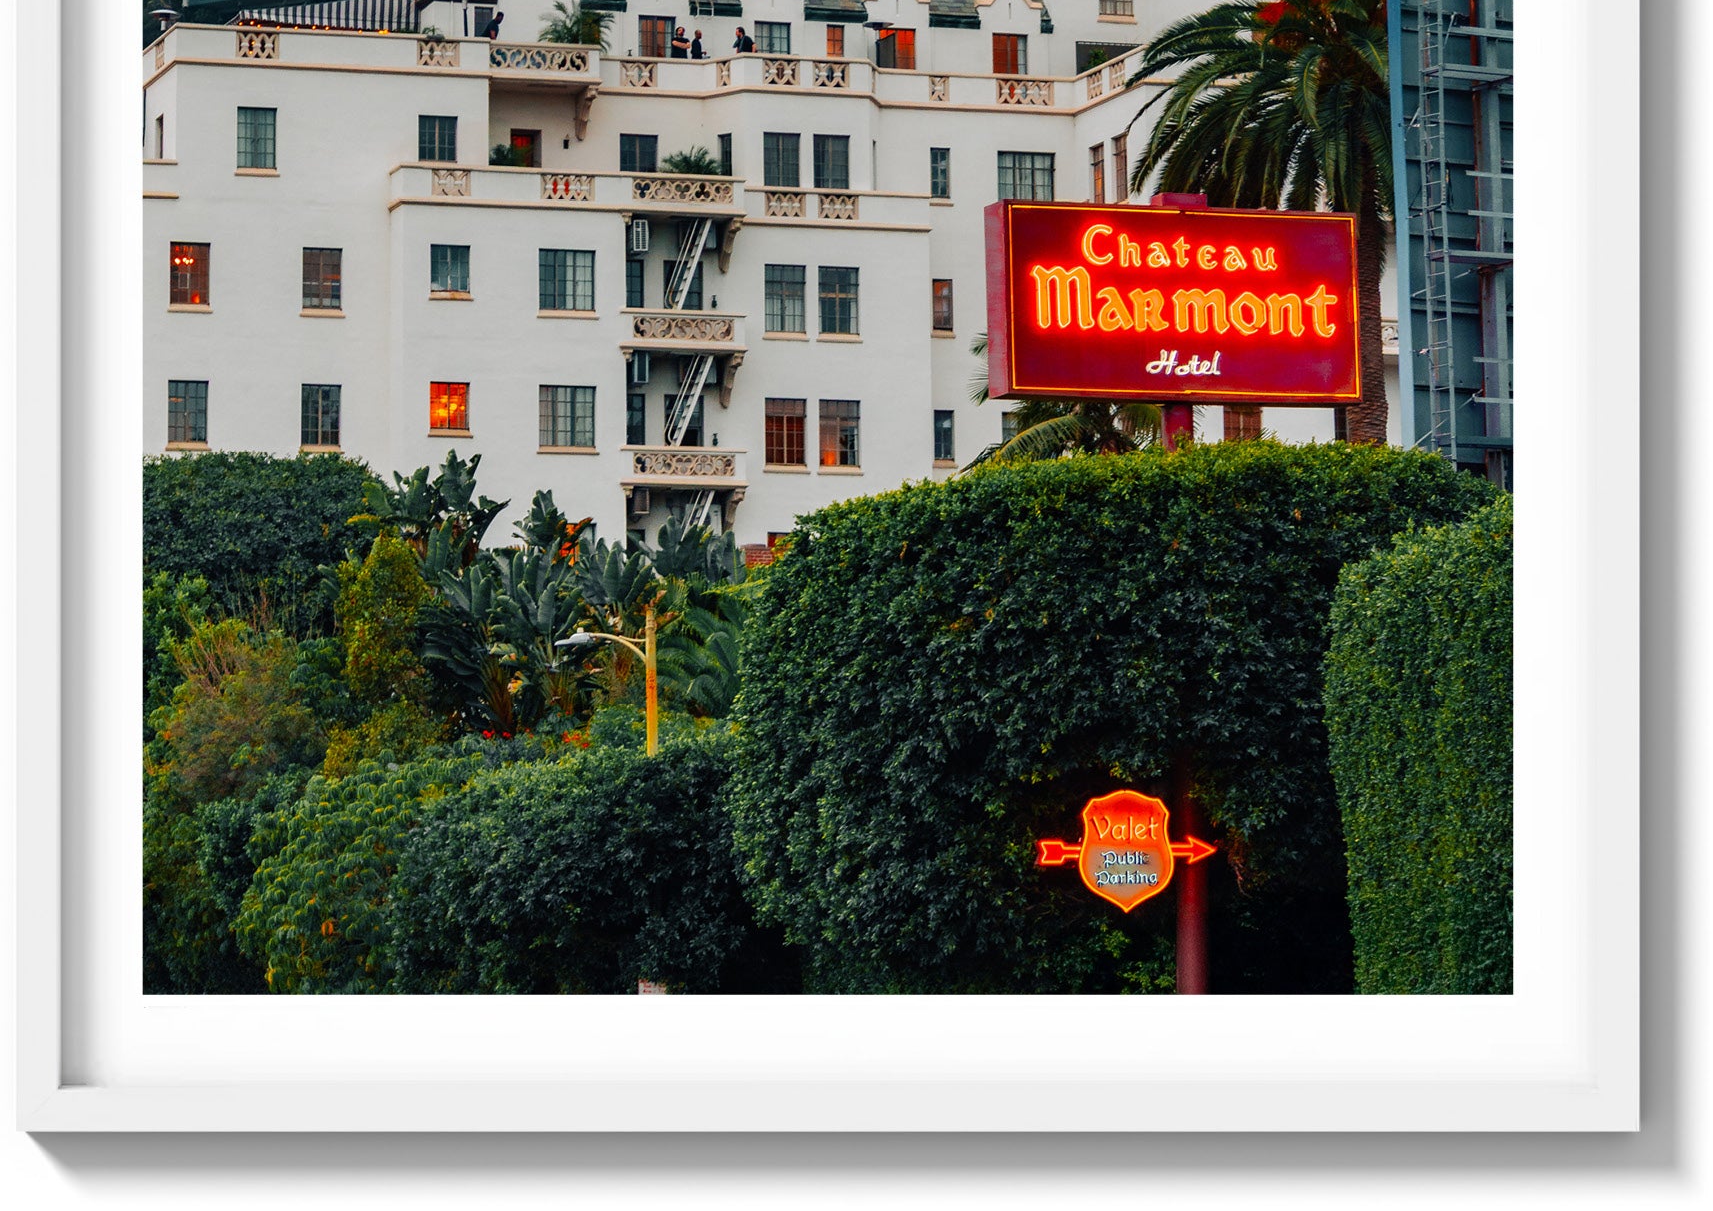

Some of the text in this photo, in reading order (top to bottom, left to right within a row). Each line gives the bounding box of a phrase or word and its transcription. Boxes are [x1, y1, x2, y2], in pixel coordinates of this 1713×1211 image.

[1082, 223, 1278, 272] Chateau
[1145, 349, 1222, 376] Hotel
[1091, 815, 1160, 841] Valet
[1101, 850, 1150, 868] Public
[1094, 870, 1159, 887] Parking
